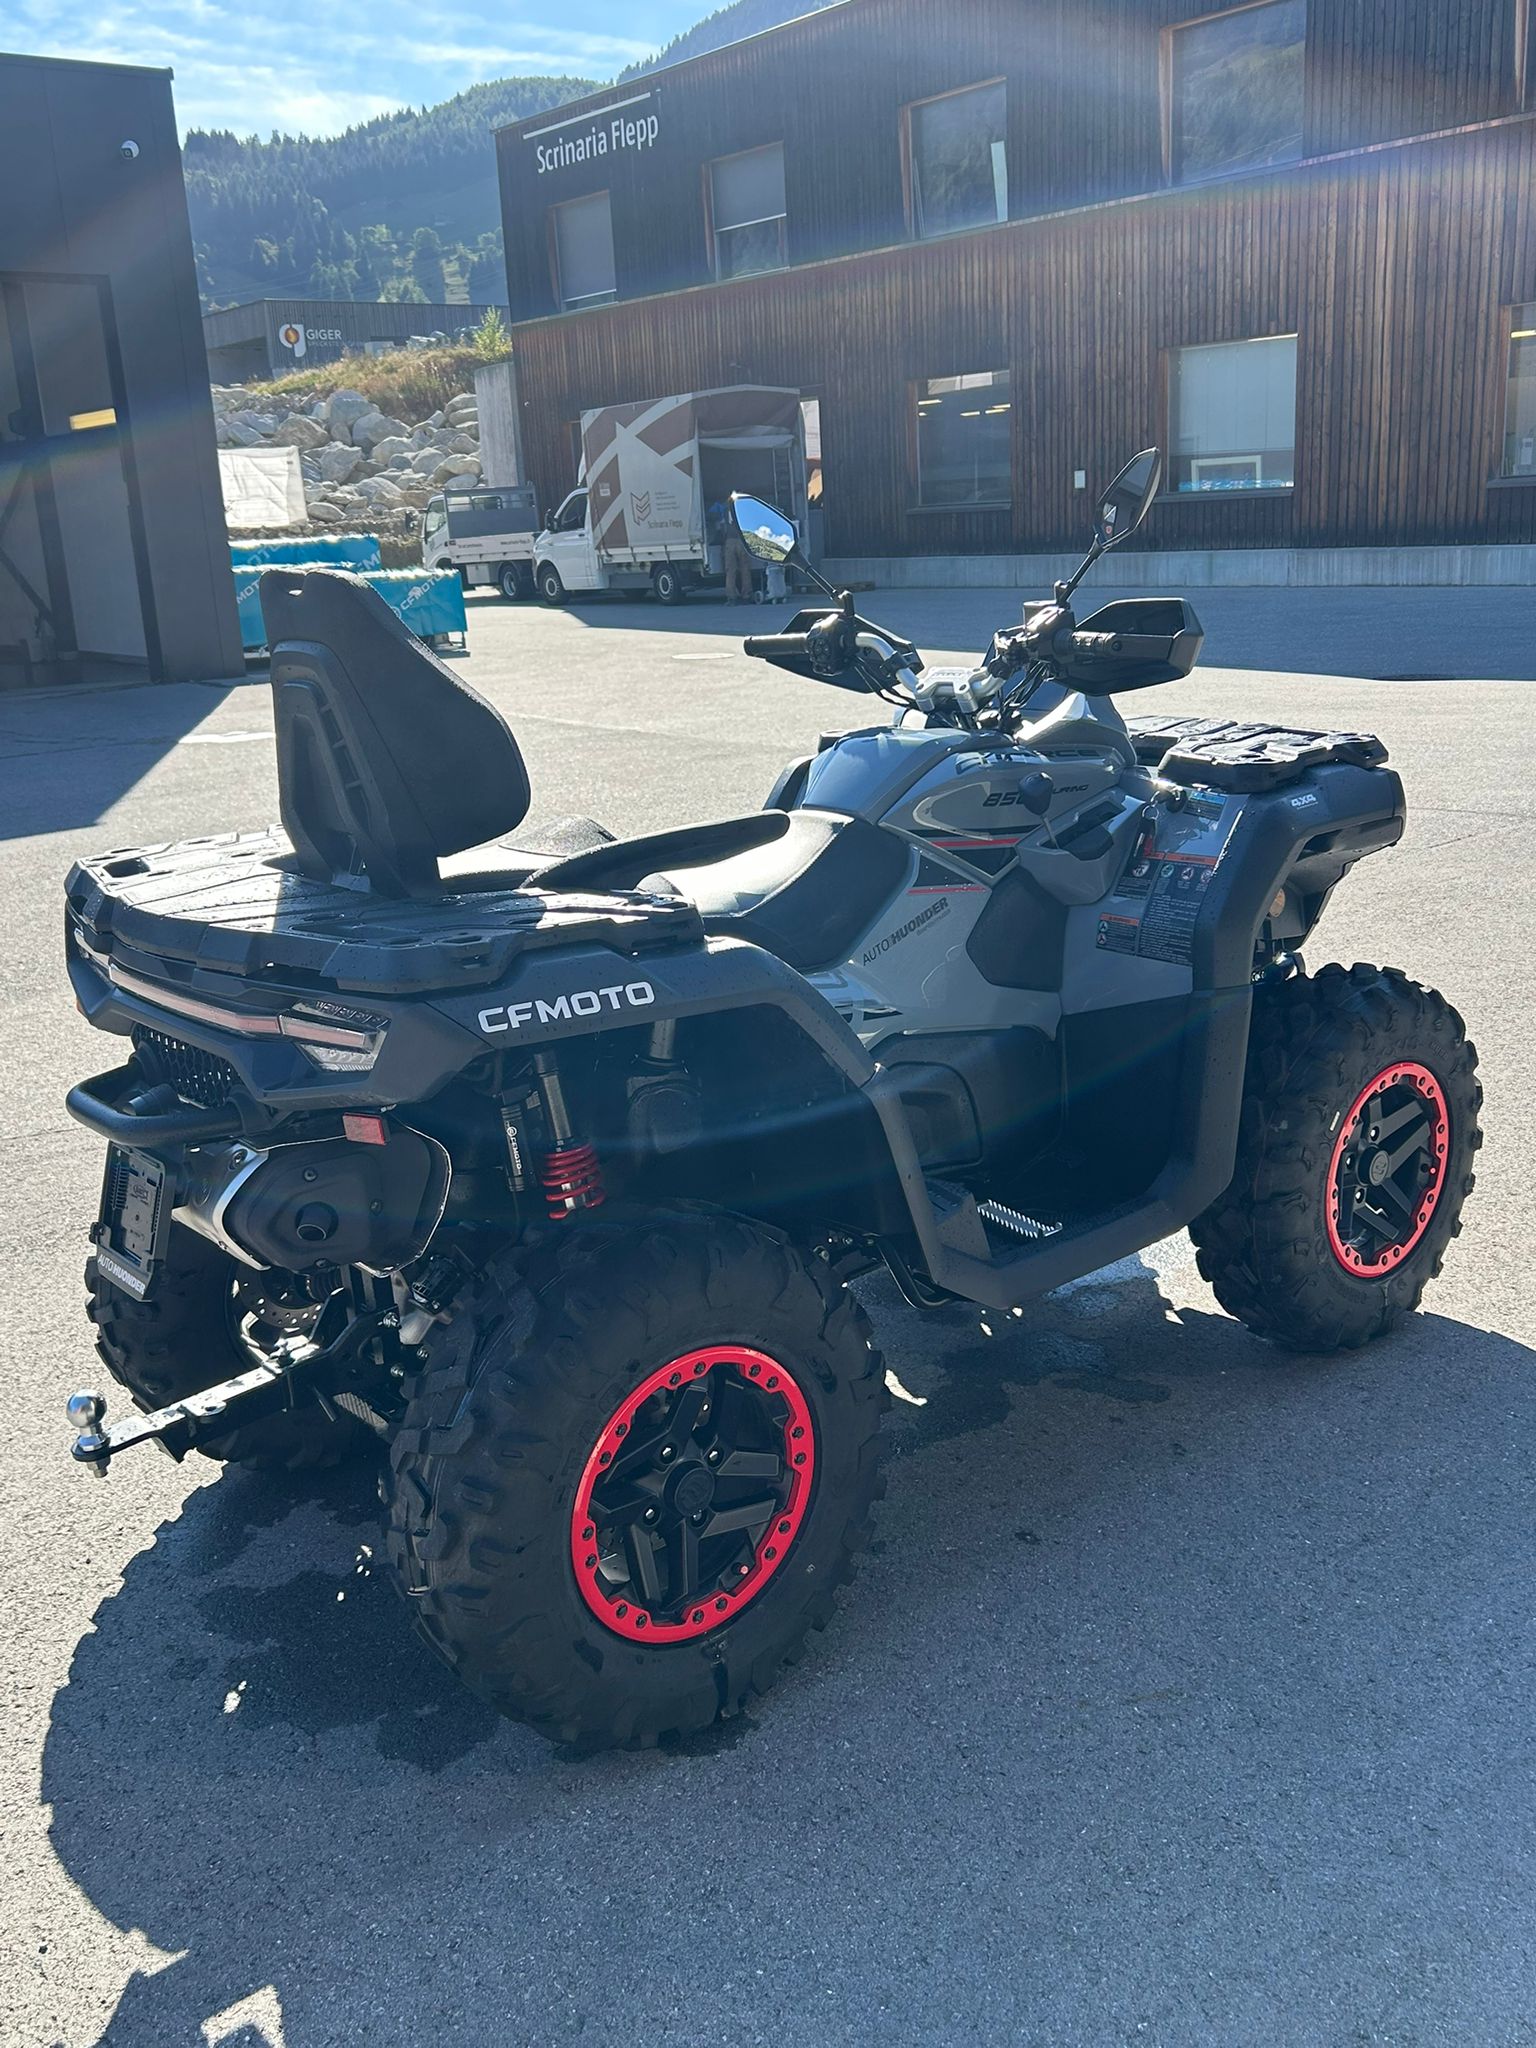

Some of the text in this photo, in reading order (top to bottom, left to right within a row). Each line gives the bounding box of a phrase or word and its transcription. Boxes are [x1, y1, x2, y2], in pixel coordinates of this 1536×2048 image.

[536, 114, 659, 174] Scrinaria Flepp
[306, 328, 342, 340] GIGER
[888, 896, 949, 946] HUONDER
[477, 981, 656, 1034] CFMOTO
[112, 1264, 146, 1295] HUONDER
